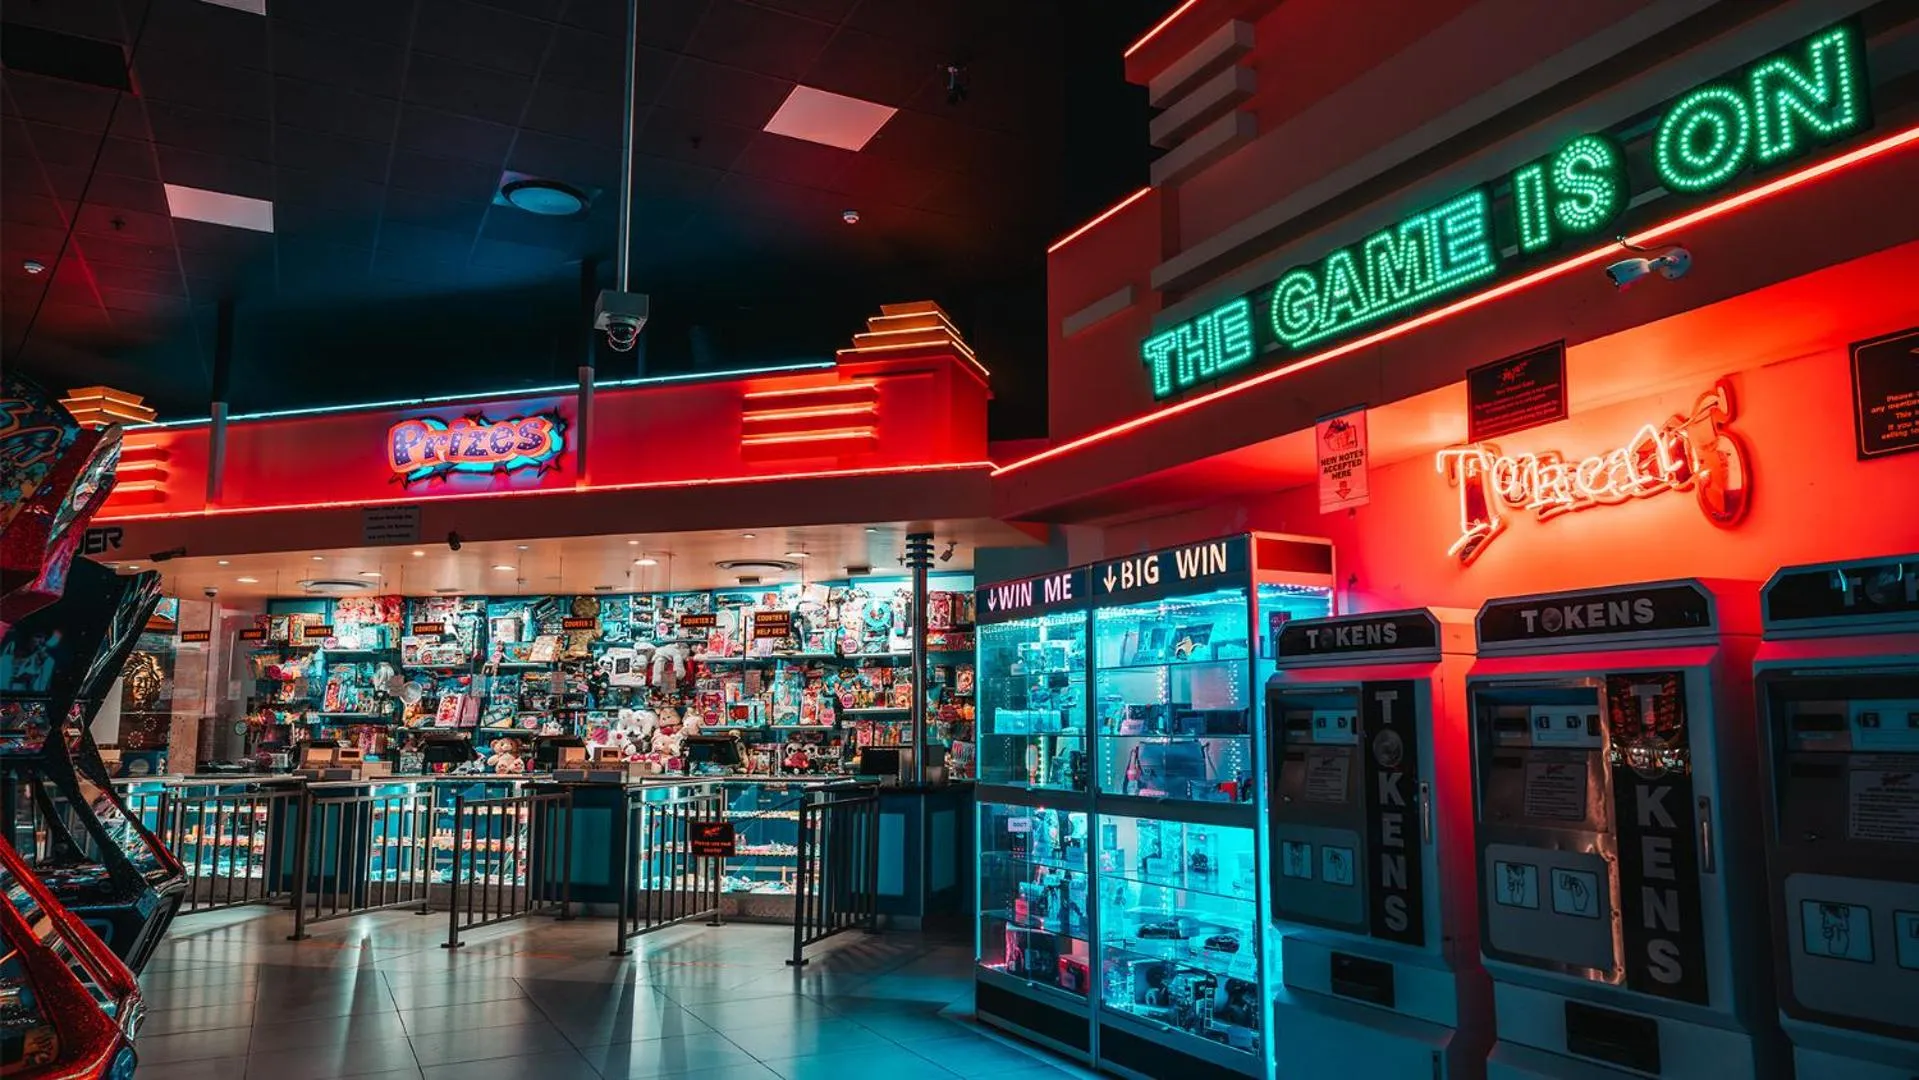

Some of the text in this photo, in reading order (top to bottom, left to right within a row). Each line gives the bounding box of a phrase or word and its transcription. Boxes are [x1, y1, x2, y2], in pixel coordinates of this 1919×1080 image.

[1143, 26, 1855, 394] THE GAME IS ON
[392, 420, 545, 466] Prizes
[1321, 450, 1364, 466] NEW NOTES
[1323, 459, 1362, 473] ACCEPTED
[1121, 542, 1227, 590] BIG WIN
[998, 574, 1072, 610] WIN ME
[1306, 622, 1398, 650] TOKENS
[1520, 597, 1655, 634] TOKENS
[1373, 690, 1409, 931] TOKENS
[1628, 684, 1684, 985] TOKENS
